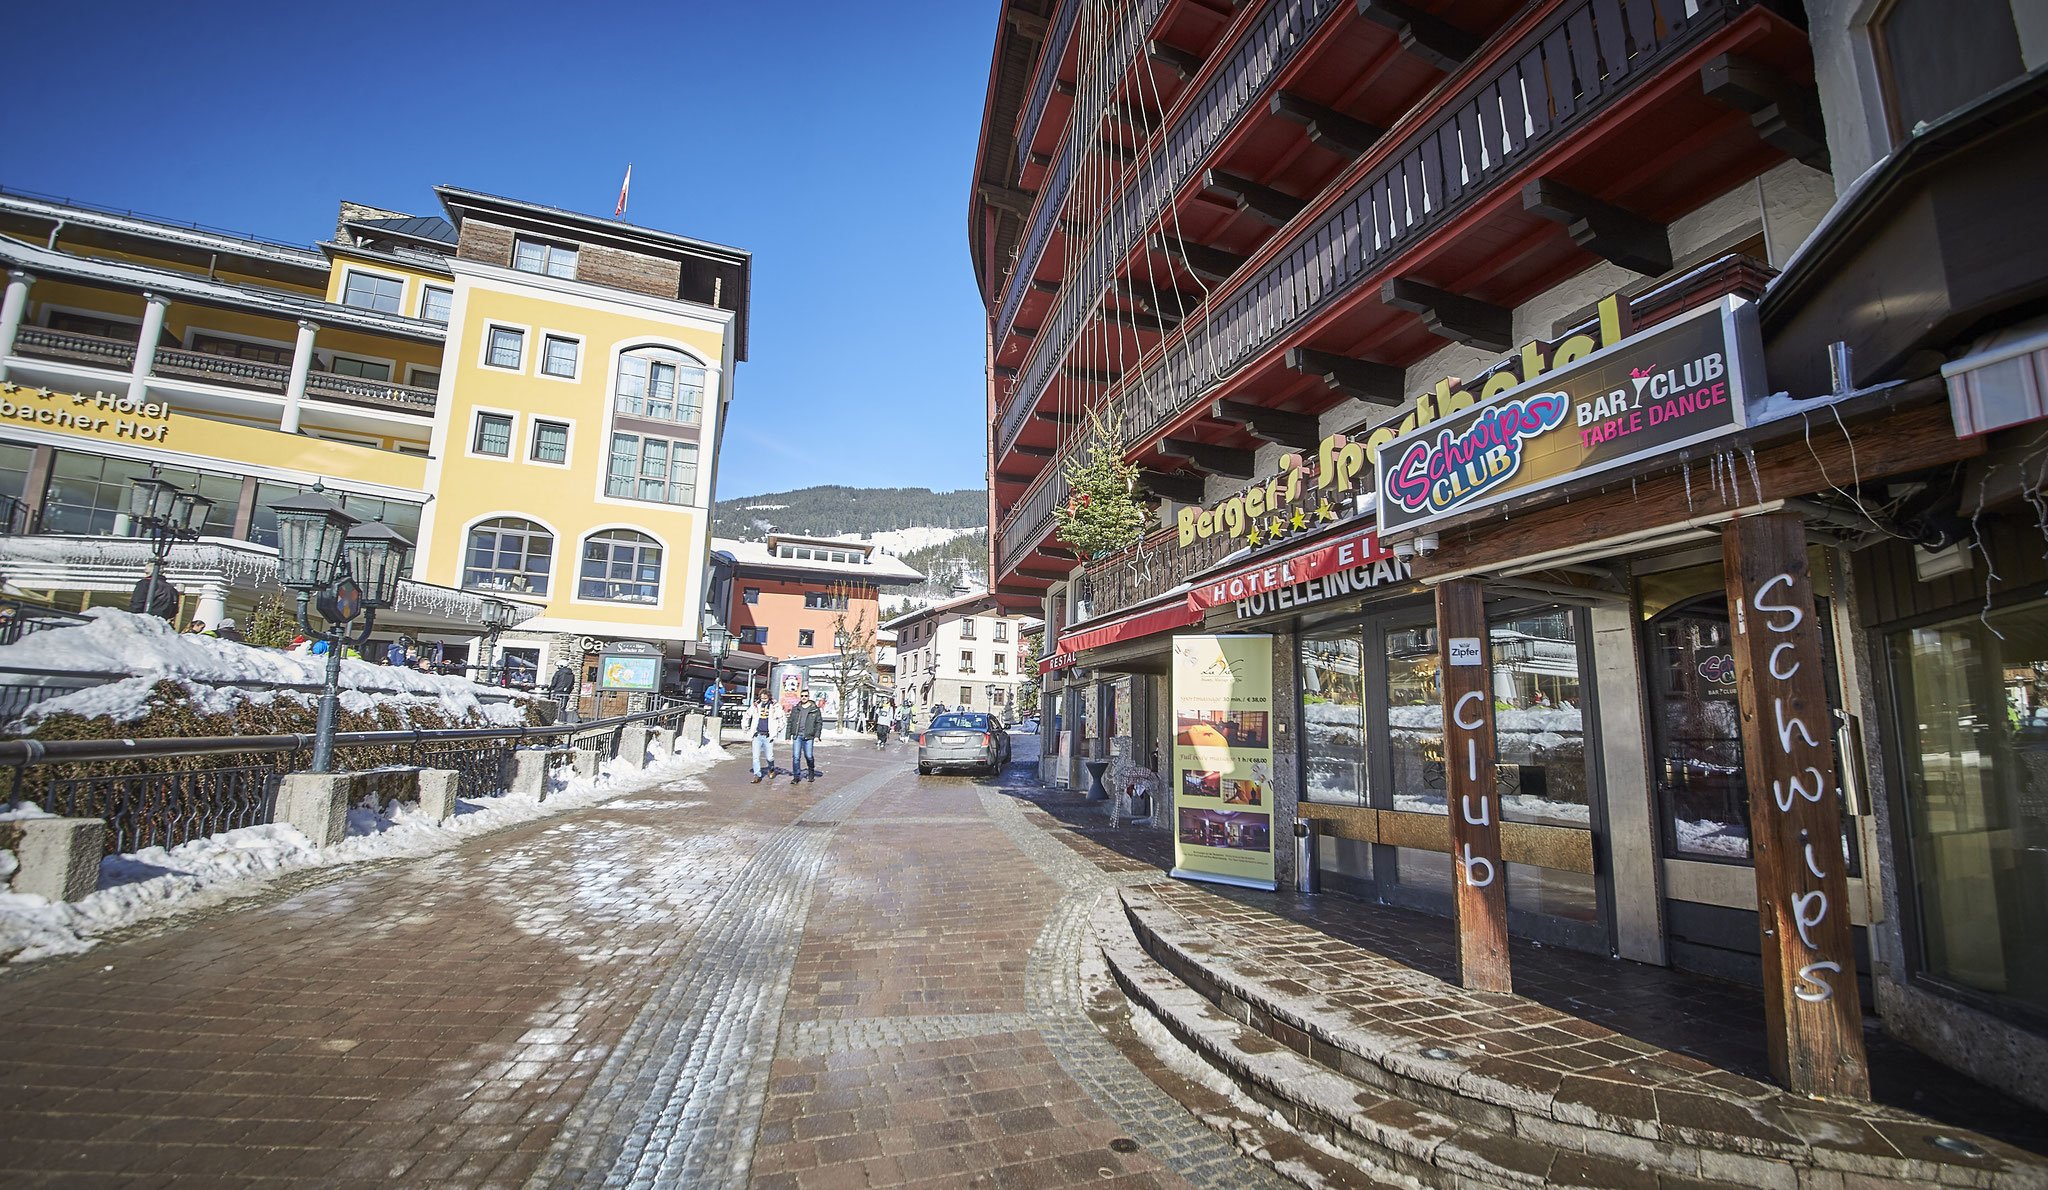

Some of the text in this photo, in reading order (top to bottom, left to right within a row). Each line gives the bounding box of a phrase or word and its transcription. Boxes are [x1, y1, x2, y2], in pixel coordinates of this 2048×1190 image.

[95, 391, 170, 418] Hotel
[1576, 352, 1724, 427] BAR CLUB
[1579, 382, 1727, 449] TABLE DANCE
[115, 419, 169, 442] Hof
[1397, 401, 1558, 506] Schwips
[1178, 453, 1302, 548] Berger's
[1432, 444, 1513, 507] CLUB
[1213, 563, 1296, 602] HOTEL
[1338, 537, 1386, 566] EI
[1451, 648, 1480, 658] Zipfer
[1453, 690, 1495, 887] Club
[1753, 572, 1841, 1002] Schwips
